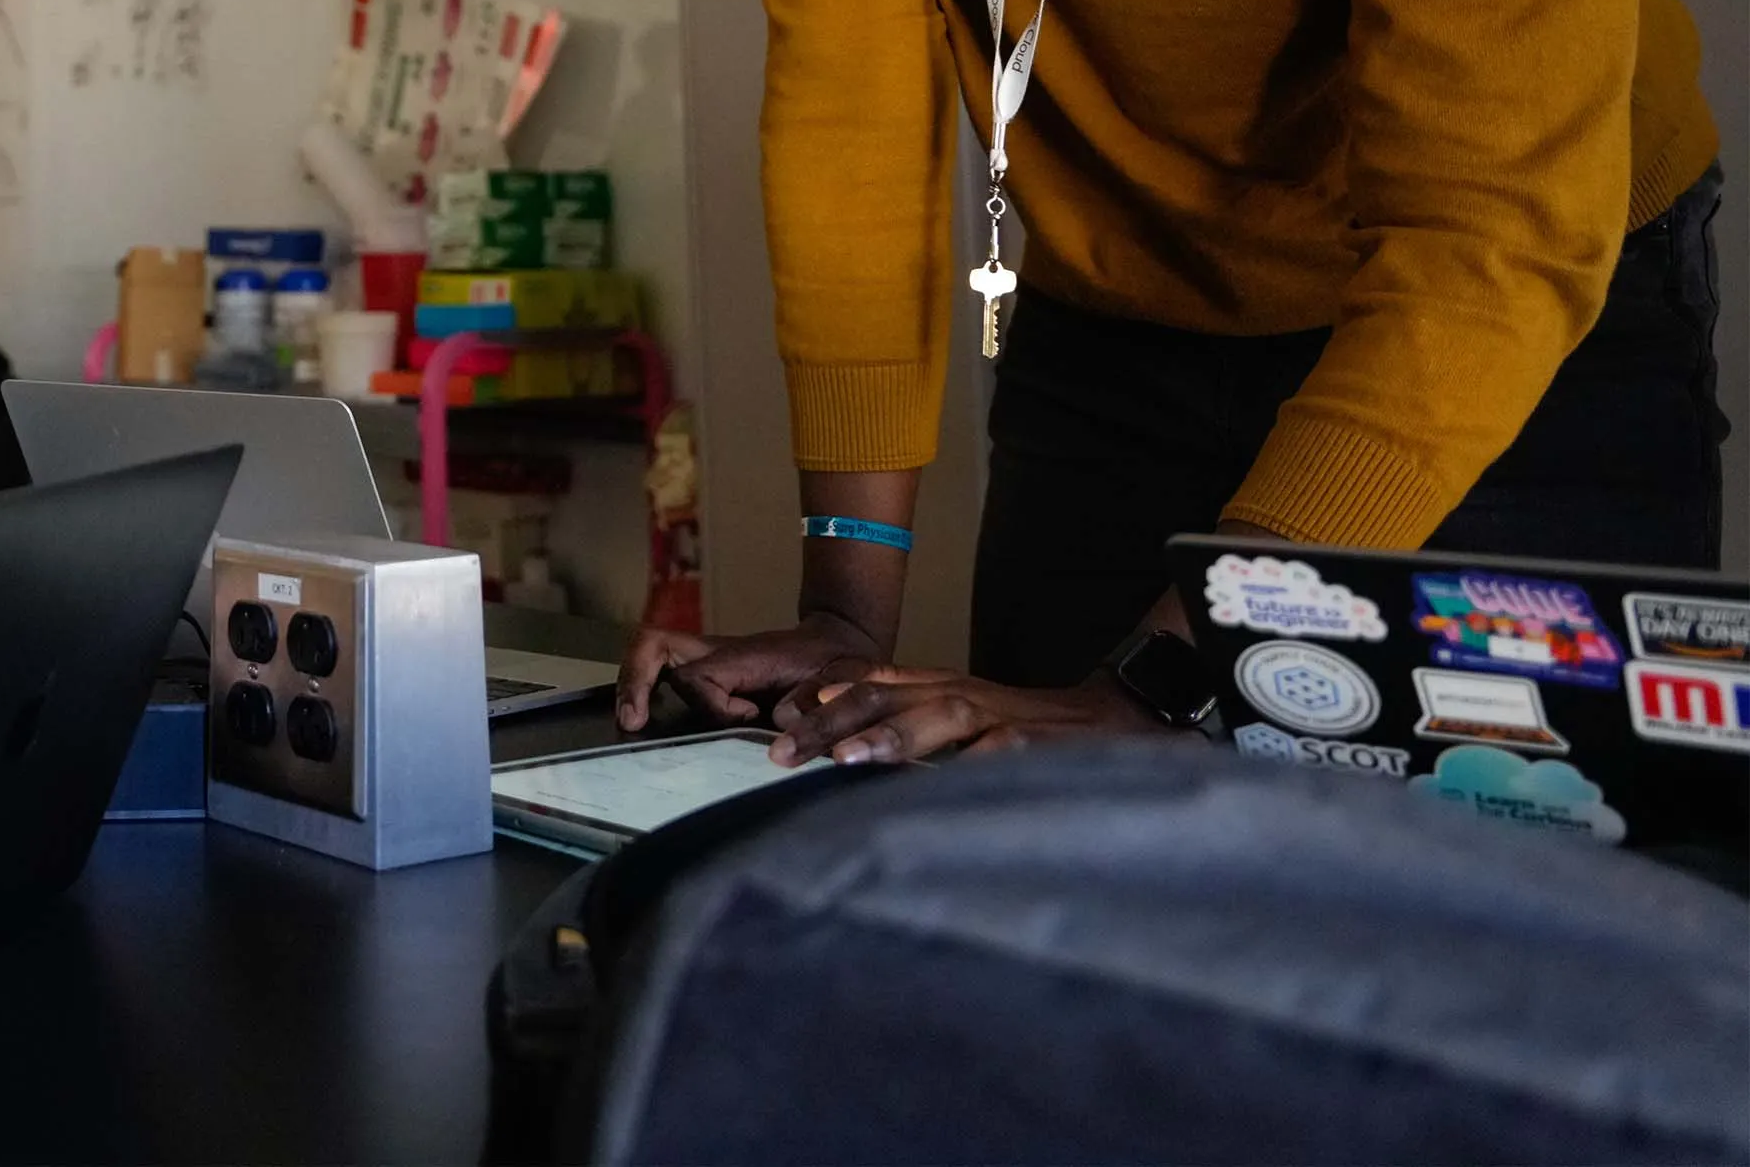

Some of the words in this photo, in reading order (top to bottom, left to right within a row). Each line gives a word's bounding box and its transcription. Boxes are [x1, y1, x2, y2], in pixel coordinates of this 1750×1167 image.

[1012, 29, 1035, 73] Cloud
[1245, 596, 1318, 616] future
[1250, 611, 1351, 630] engineer
[1639, 616, 1691, 637] DAY
[1301, 741, 1402, 775] SCOT
